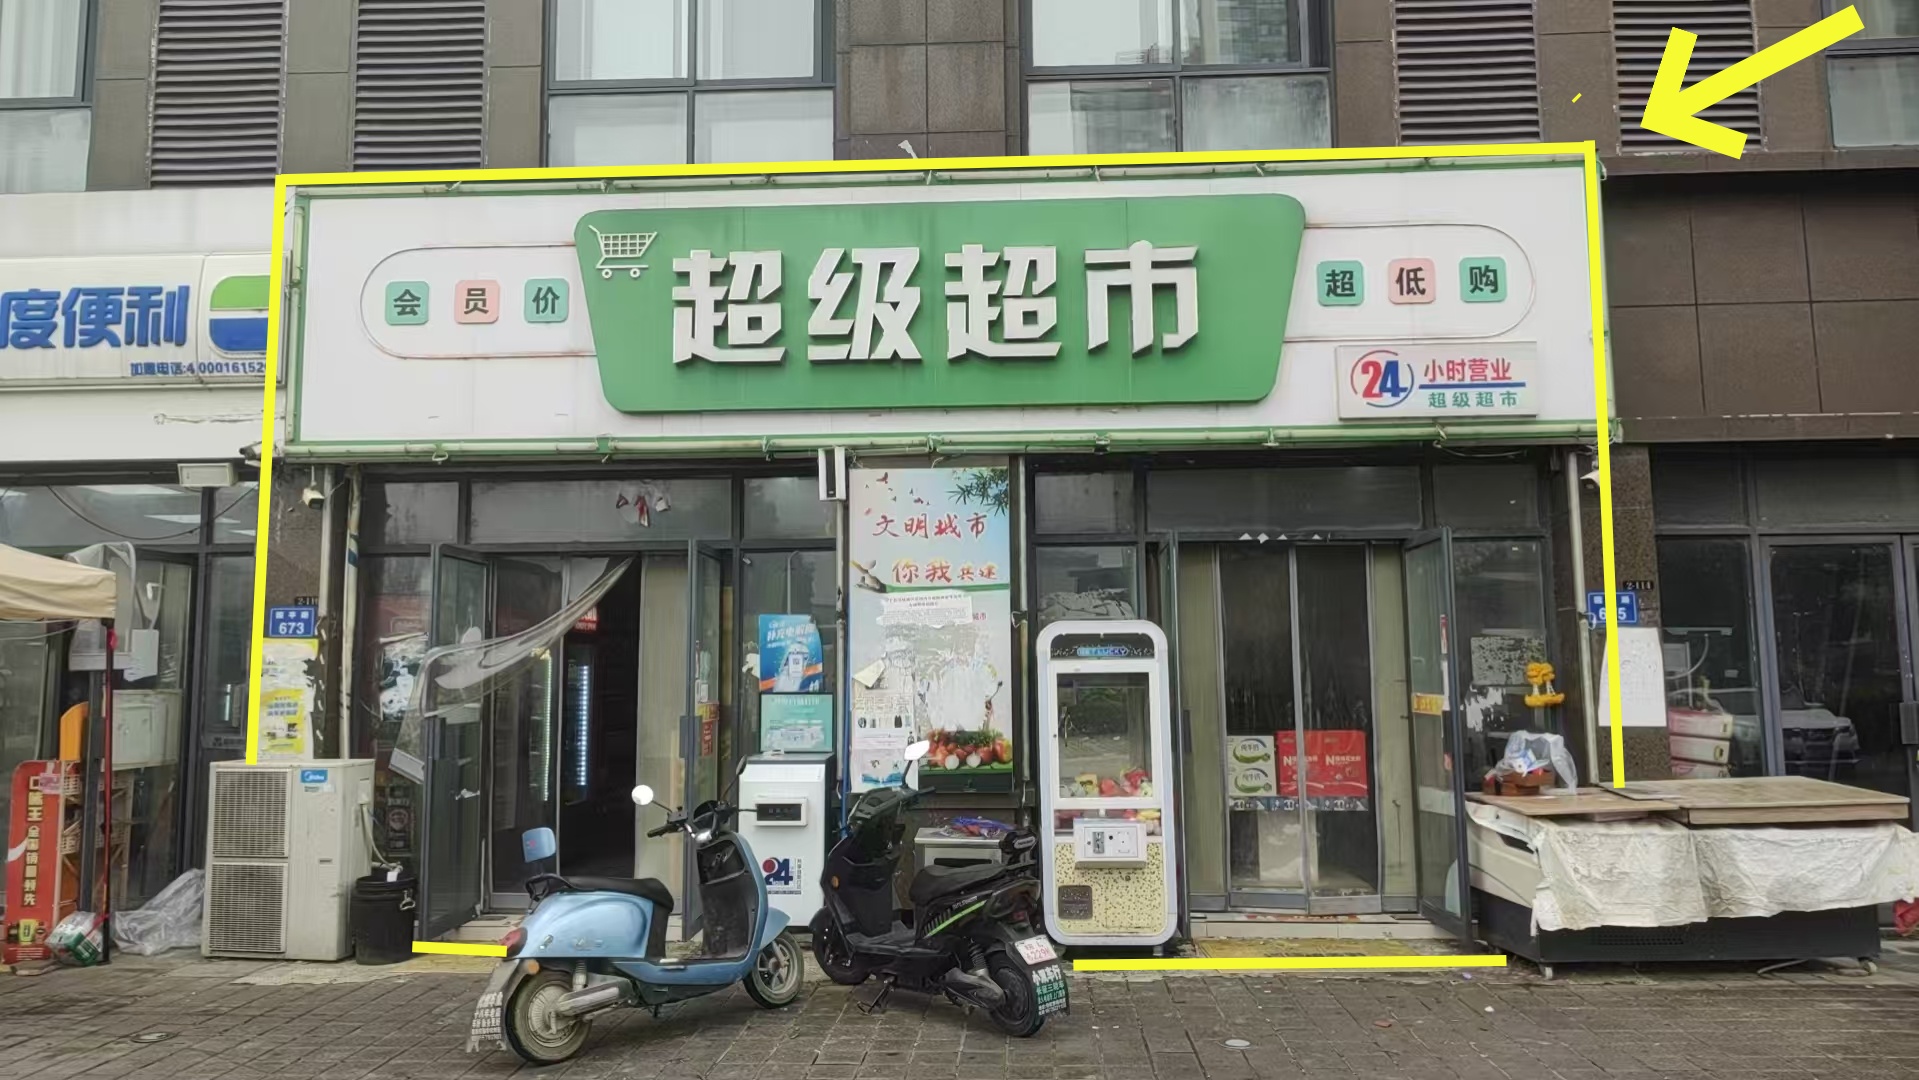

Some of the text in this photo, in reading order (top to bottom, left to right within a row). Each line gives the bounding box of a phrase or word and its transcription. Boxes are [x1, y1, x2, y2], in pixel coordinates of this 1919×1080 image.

[1325, 265, 1498, 297] 超低购
[392, 286, 560, 317] 会员价
[673, 240, 1199, 366] 超级超市
[0, 285, 190, 349] 度便利
[1361, 360, 1407, 398] 24
[1423, 357, 1513, 383] 小时营业
[1428, 391, 1518, 408] 超级超市
[872, 512, 988, 539] 文明城市
[279, 622, 305, 634] 673
[1599, 607, 1627, 620] 65
